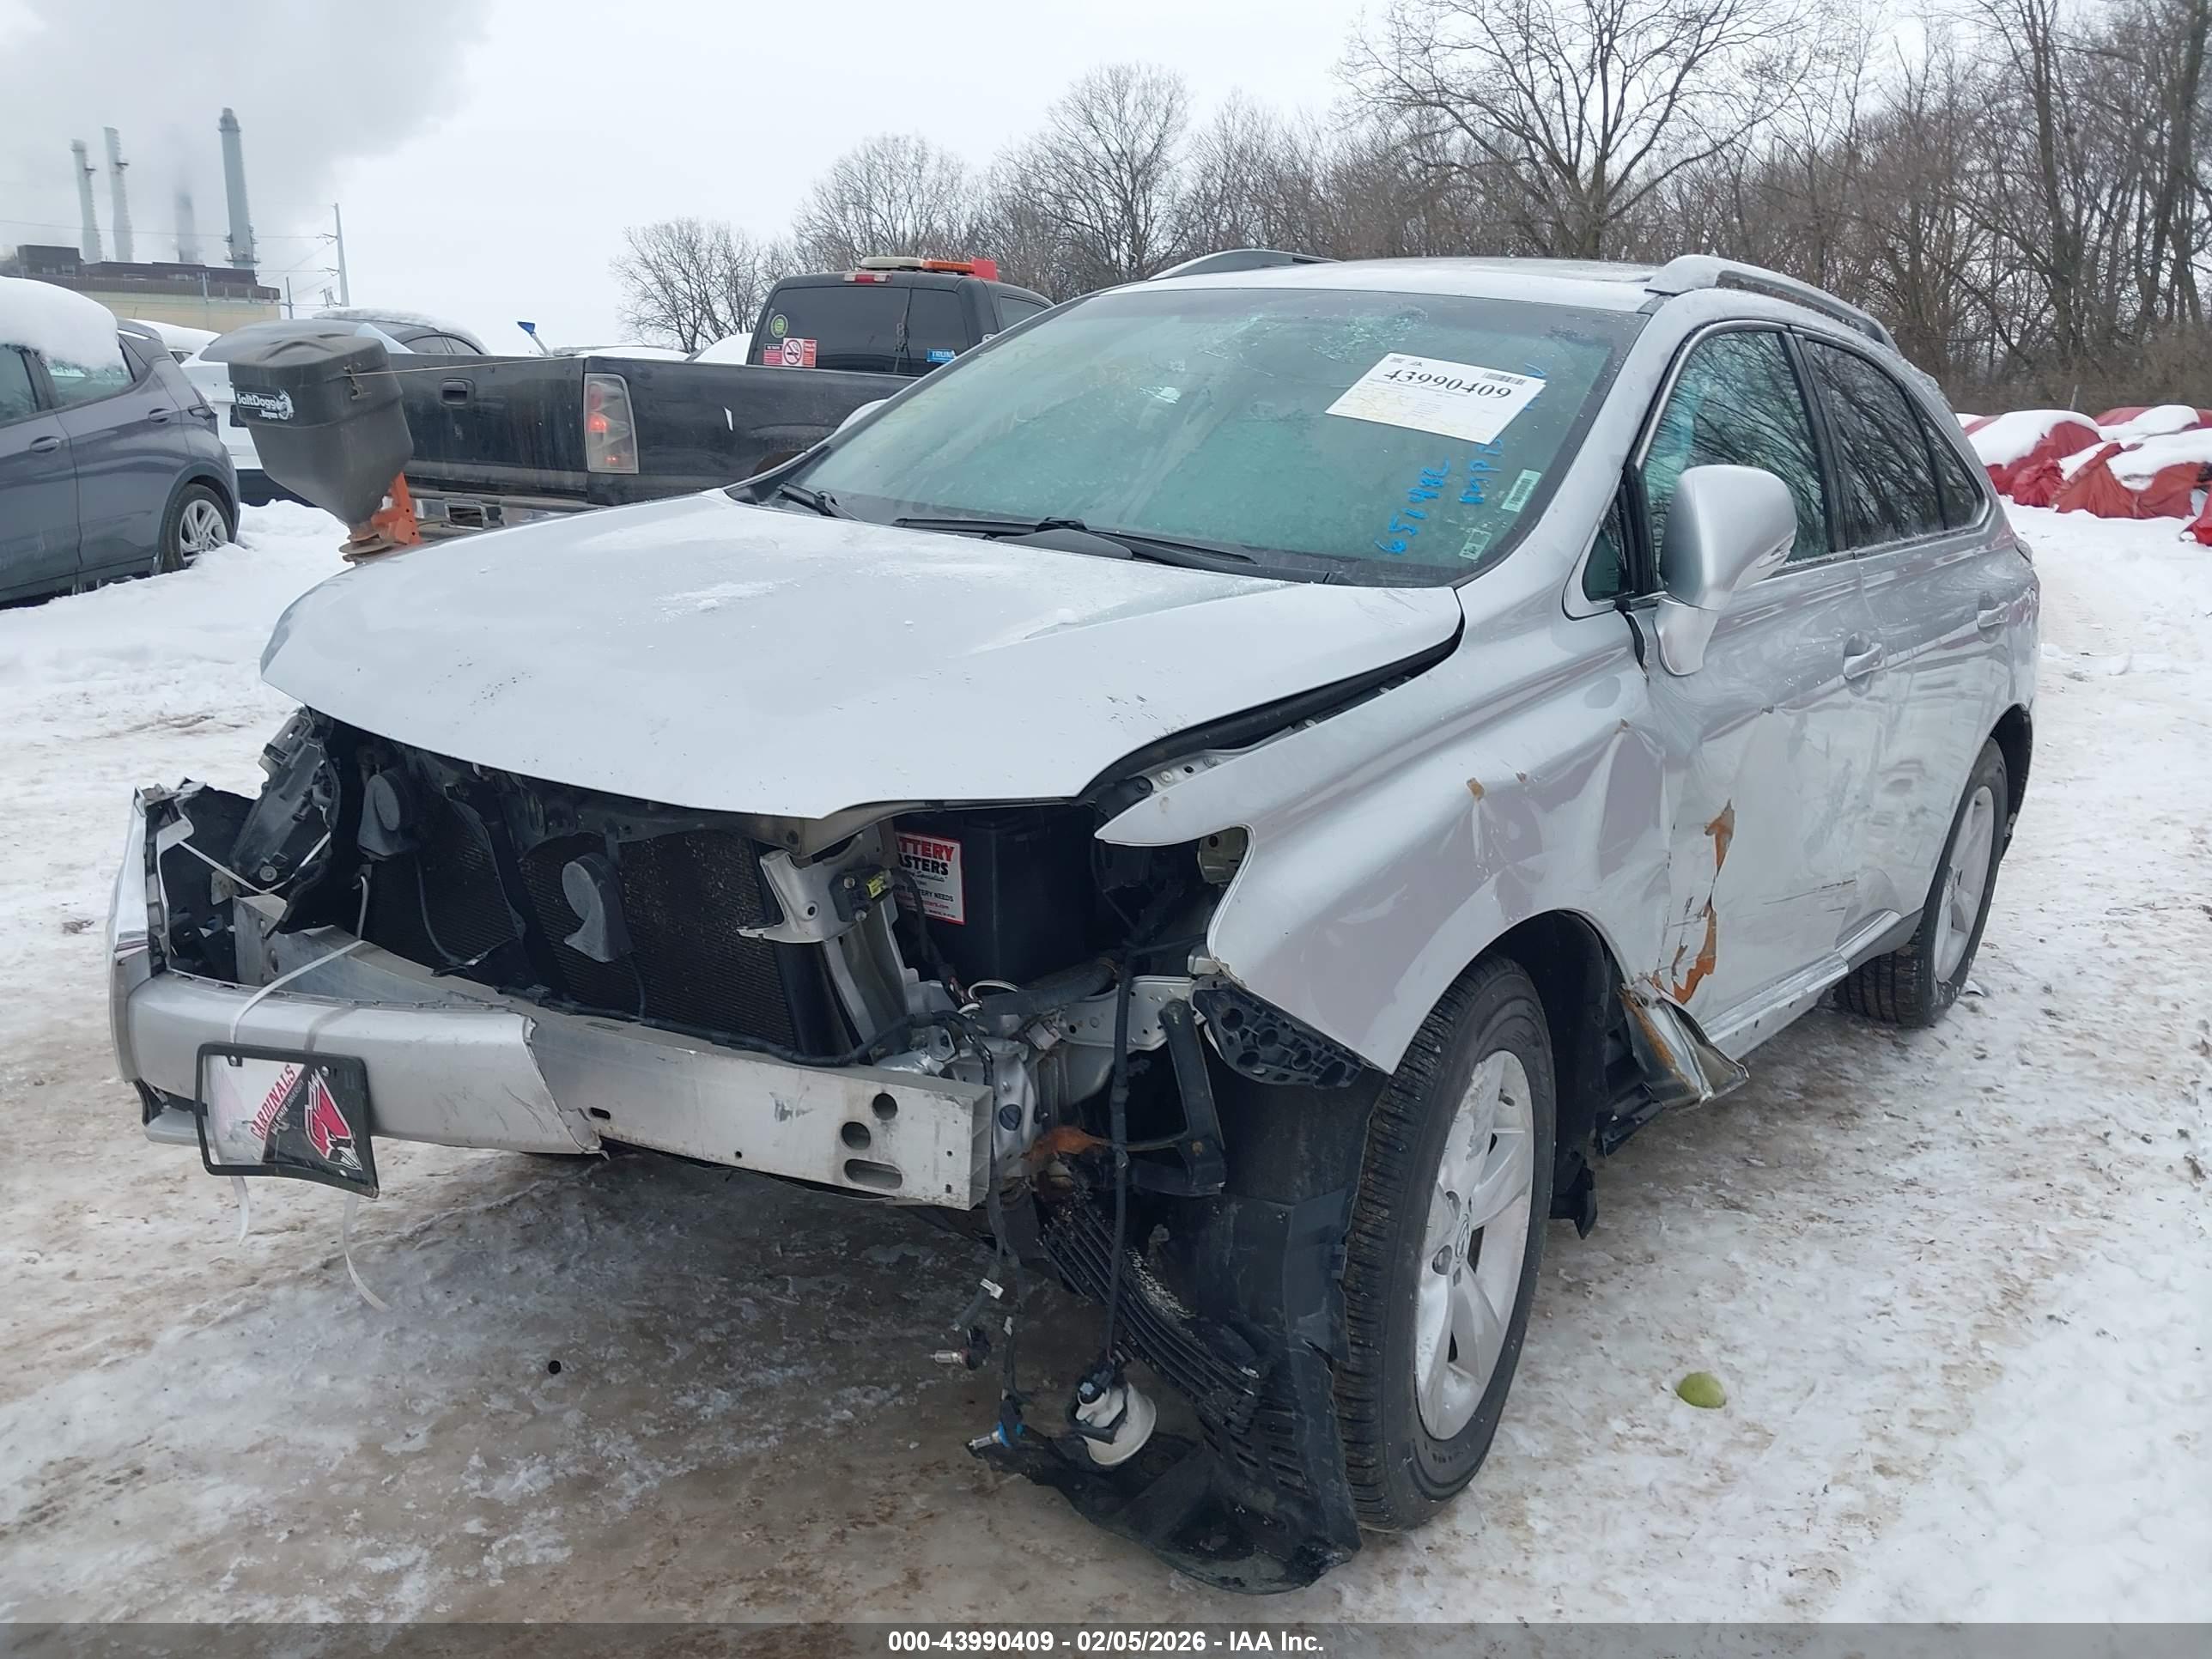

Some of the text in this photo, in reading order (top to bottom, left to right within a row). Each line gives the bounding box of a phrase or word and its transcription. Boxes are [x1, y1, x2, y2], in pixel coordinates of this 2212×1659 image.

[1383, 369, 1512, 398] 43990409
[236, 392, 276, 410] SaltDogg
[899, 837, 955, 861] TTERY
[899, 854, 949, 876] STERS
[934, 892, 954, 902] NEEDS
[250, 1063, 296, 1141] CARDINALS
